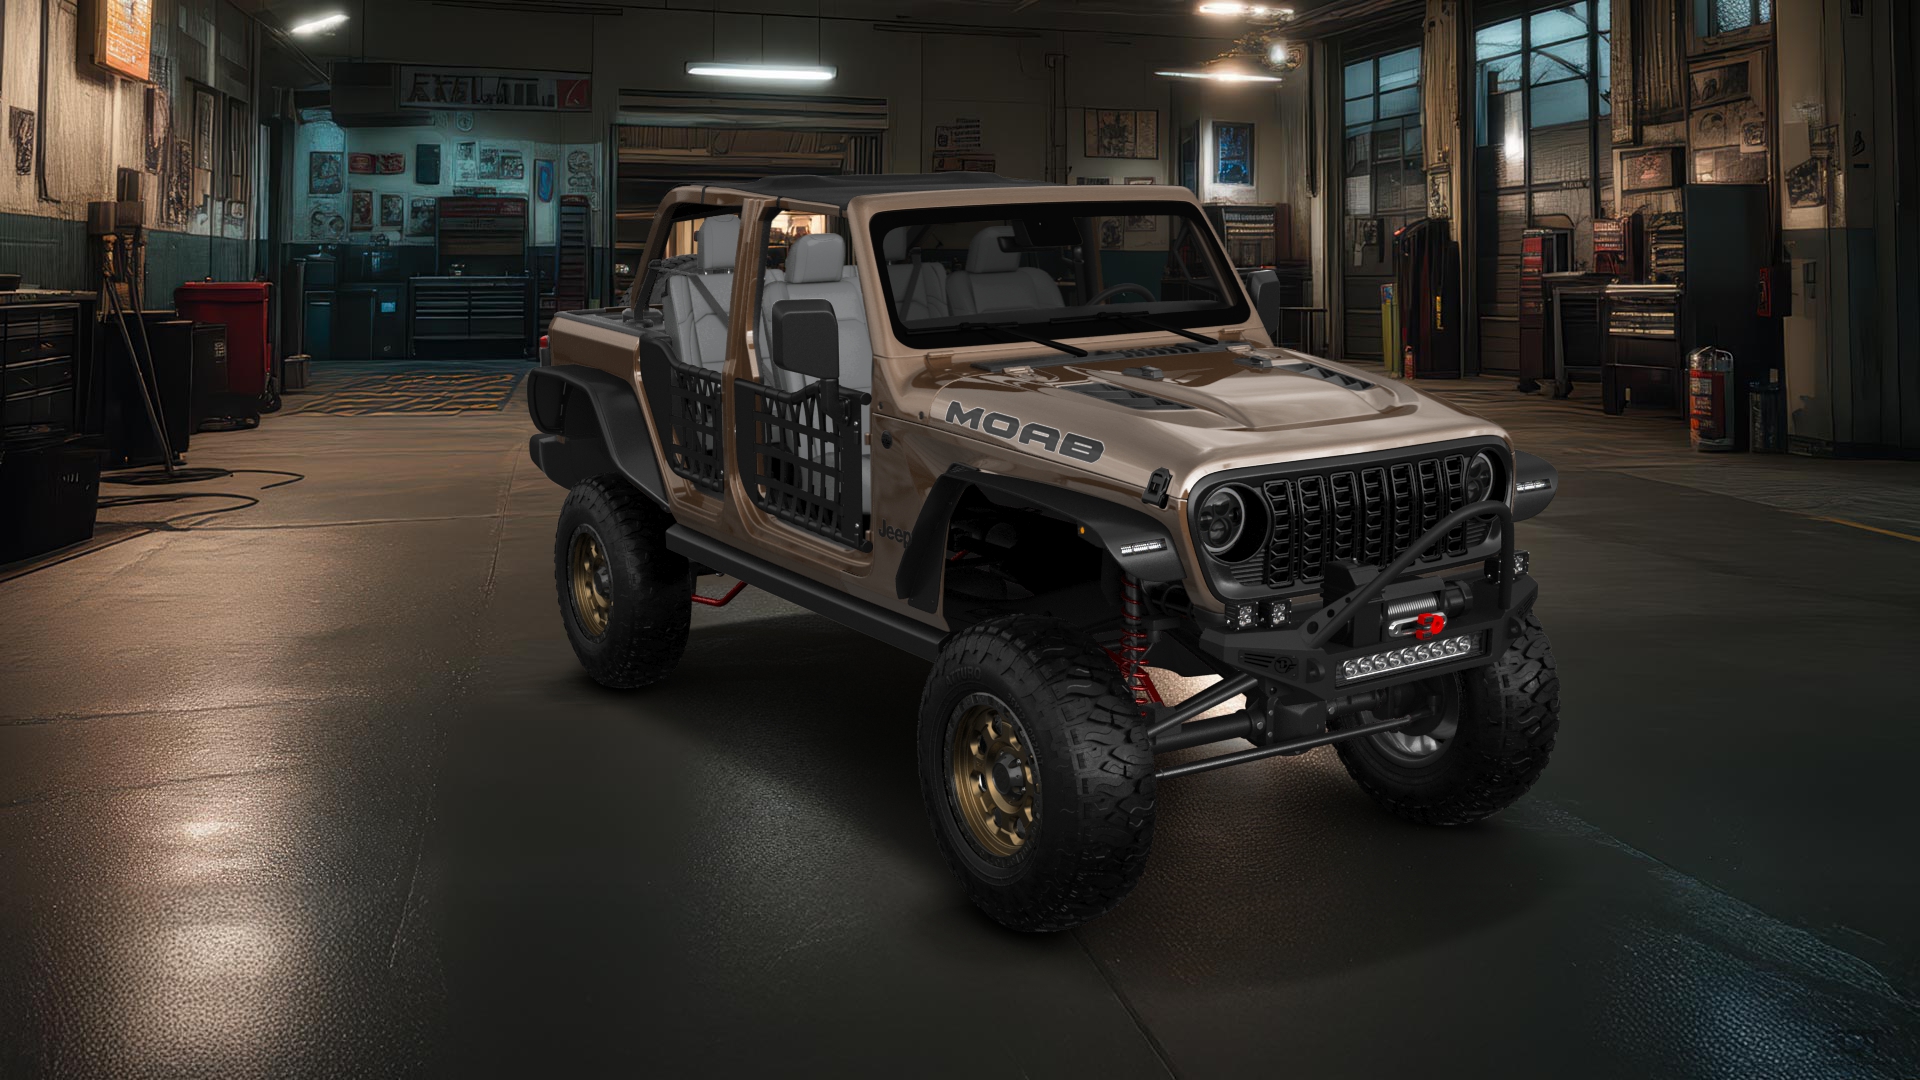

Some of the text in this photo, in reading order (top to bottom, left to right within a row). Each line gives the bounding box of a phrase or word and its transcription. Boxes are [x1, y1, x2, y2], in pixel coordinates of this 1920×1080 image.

[945, 400, 1105, 464] MOAB
[878, 518, 912, 549] Jeep
[945, 665, 982, 690] ATTURO
